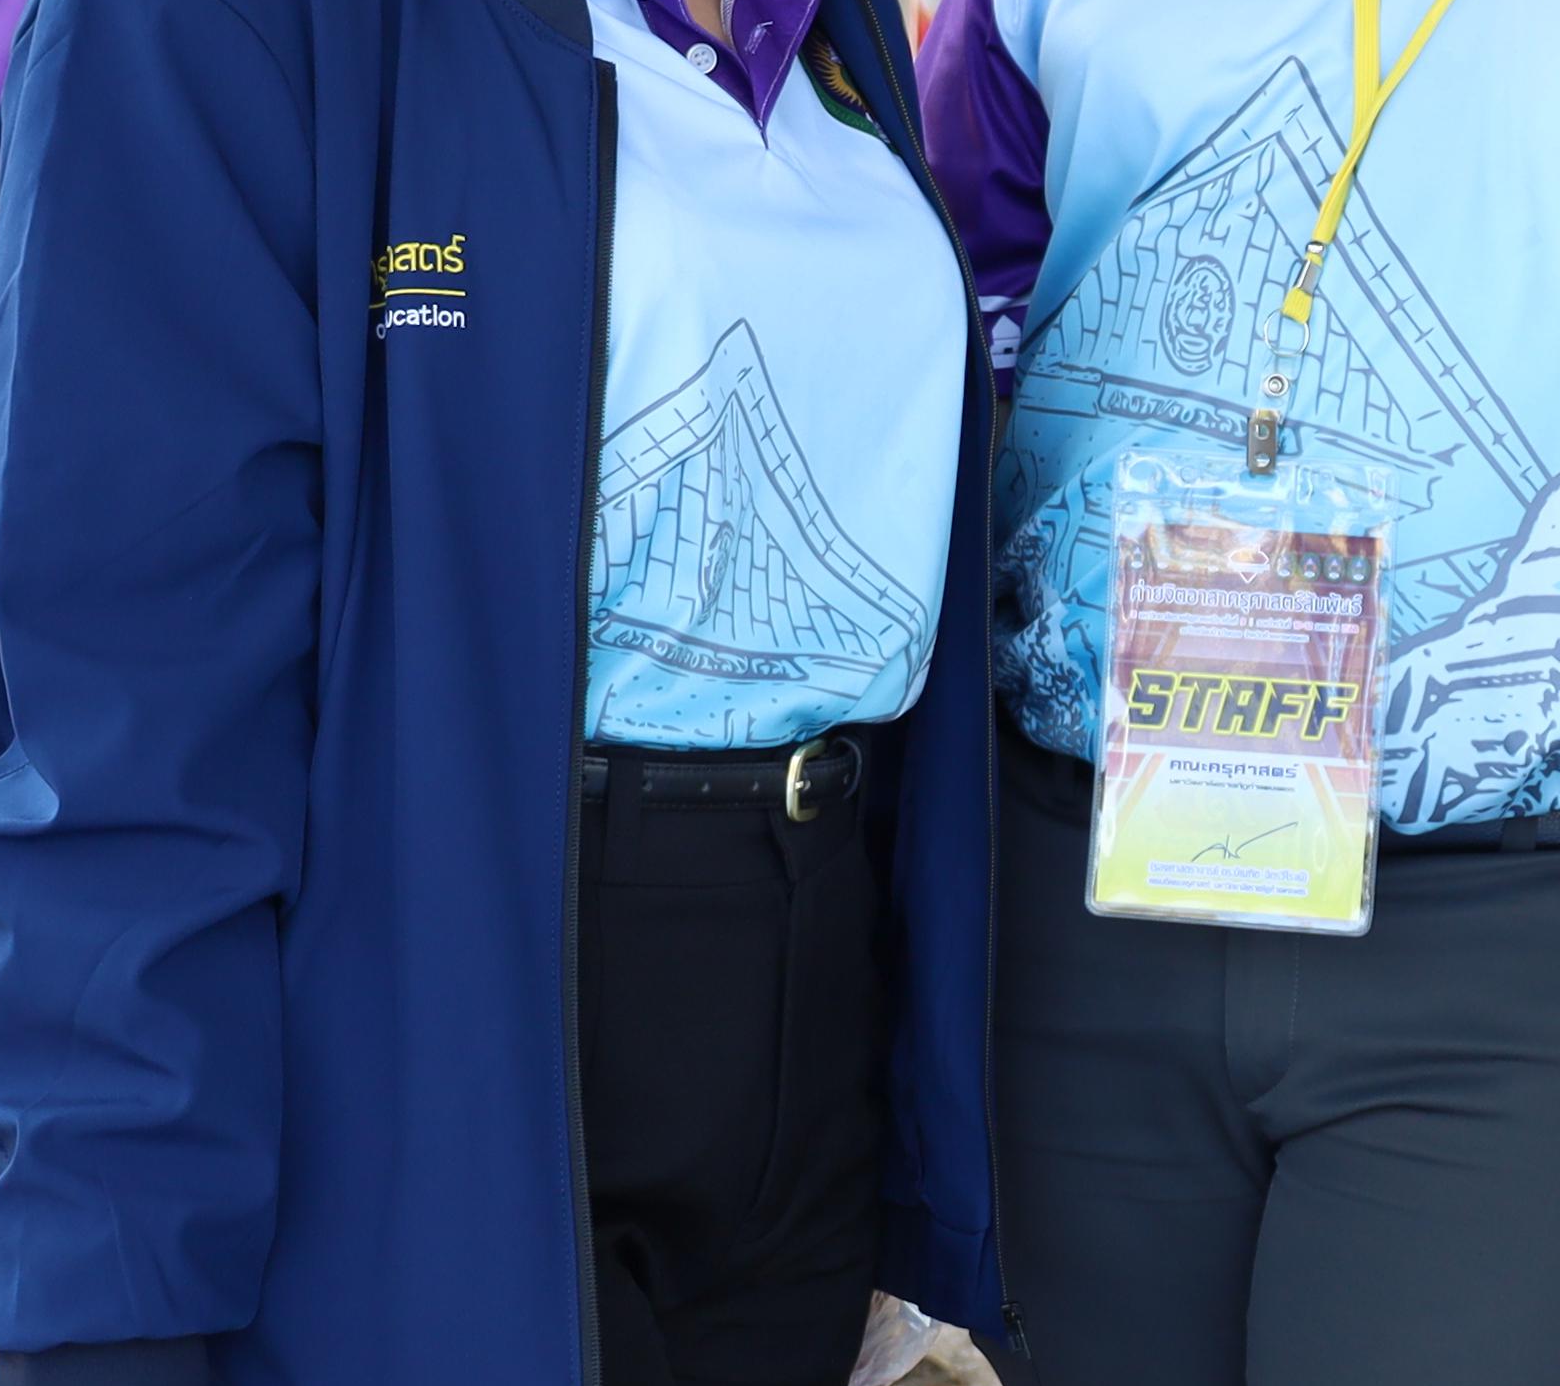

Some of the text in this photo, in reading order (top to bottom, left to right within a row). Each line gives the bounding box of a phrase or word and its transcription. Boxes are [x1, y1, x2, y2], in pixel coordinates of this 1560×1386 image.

[385, 234, 466, 273] าสตร์
[385, 304, 466, 329] ucation
[1126, 668, 1359, 740] STAFF
[1169, 759, 1299, 779] คณะครุศาสตร์
